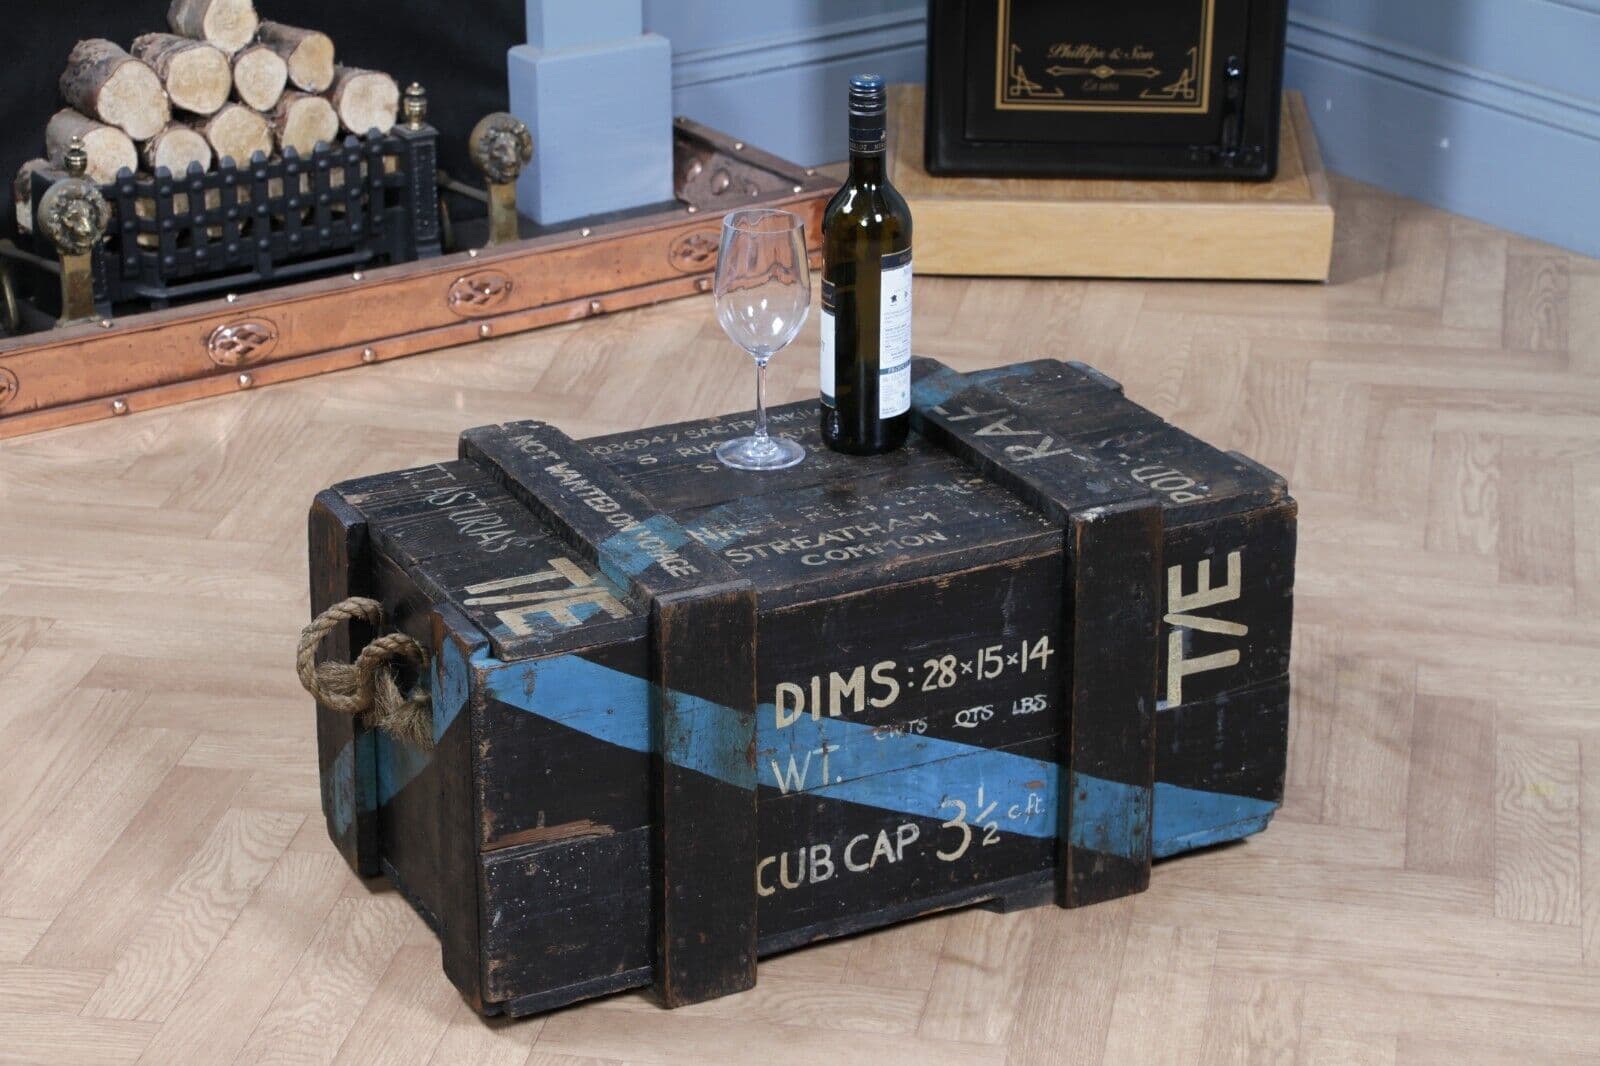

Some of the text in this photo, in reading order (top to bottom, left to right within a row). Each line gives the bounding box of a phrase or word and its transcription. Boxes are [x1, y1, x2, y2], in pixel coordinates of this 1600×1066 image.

[509, 434, 561, 460] NOT
[544, 461, 622, 513] WANTED
[606, 512, 647, 533] ON
[638, 531, 700, 578] VOYAGE
[725, 511, 943, 564] STREATHAM
[800, 530, 948, 566] COMMON
[952, 704, 994, 728] QTS
[1011, 694, 1048, 716] LBS
